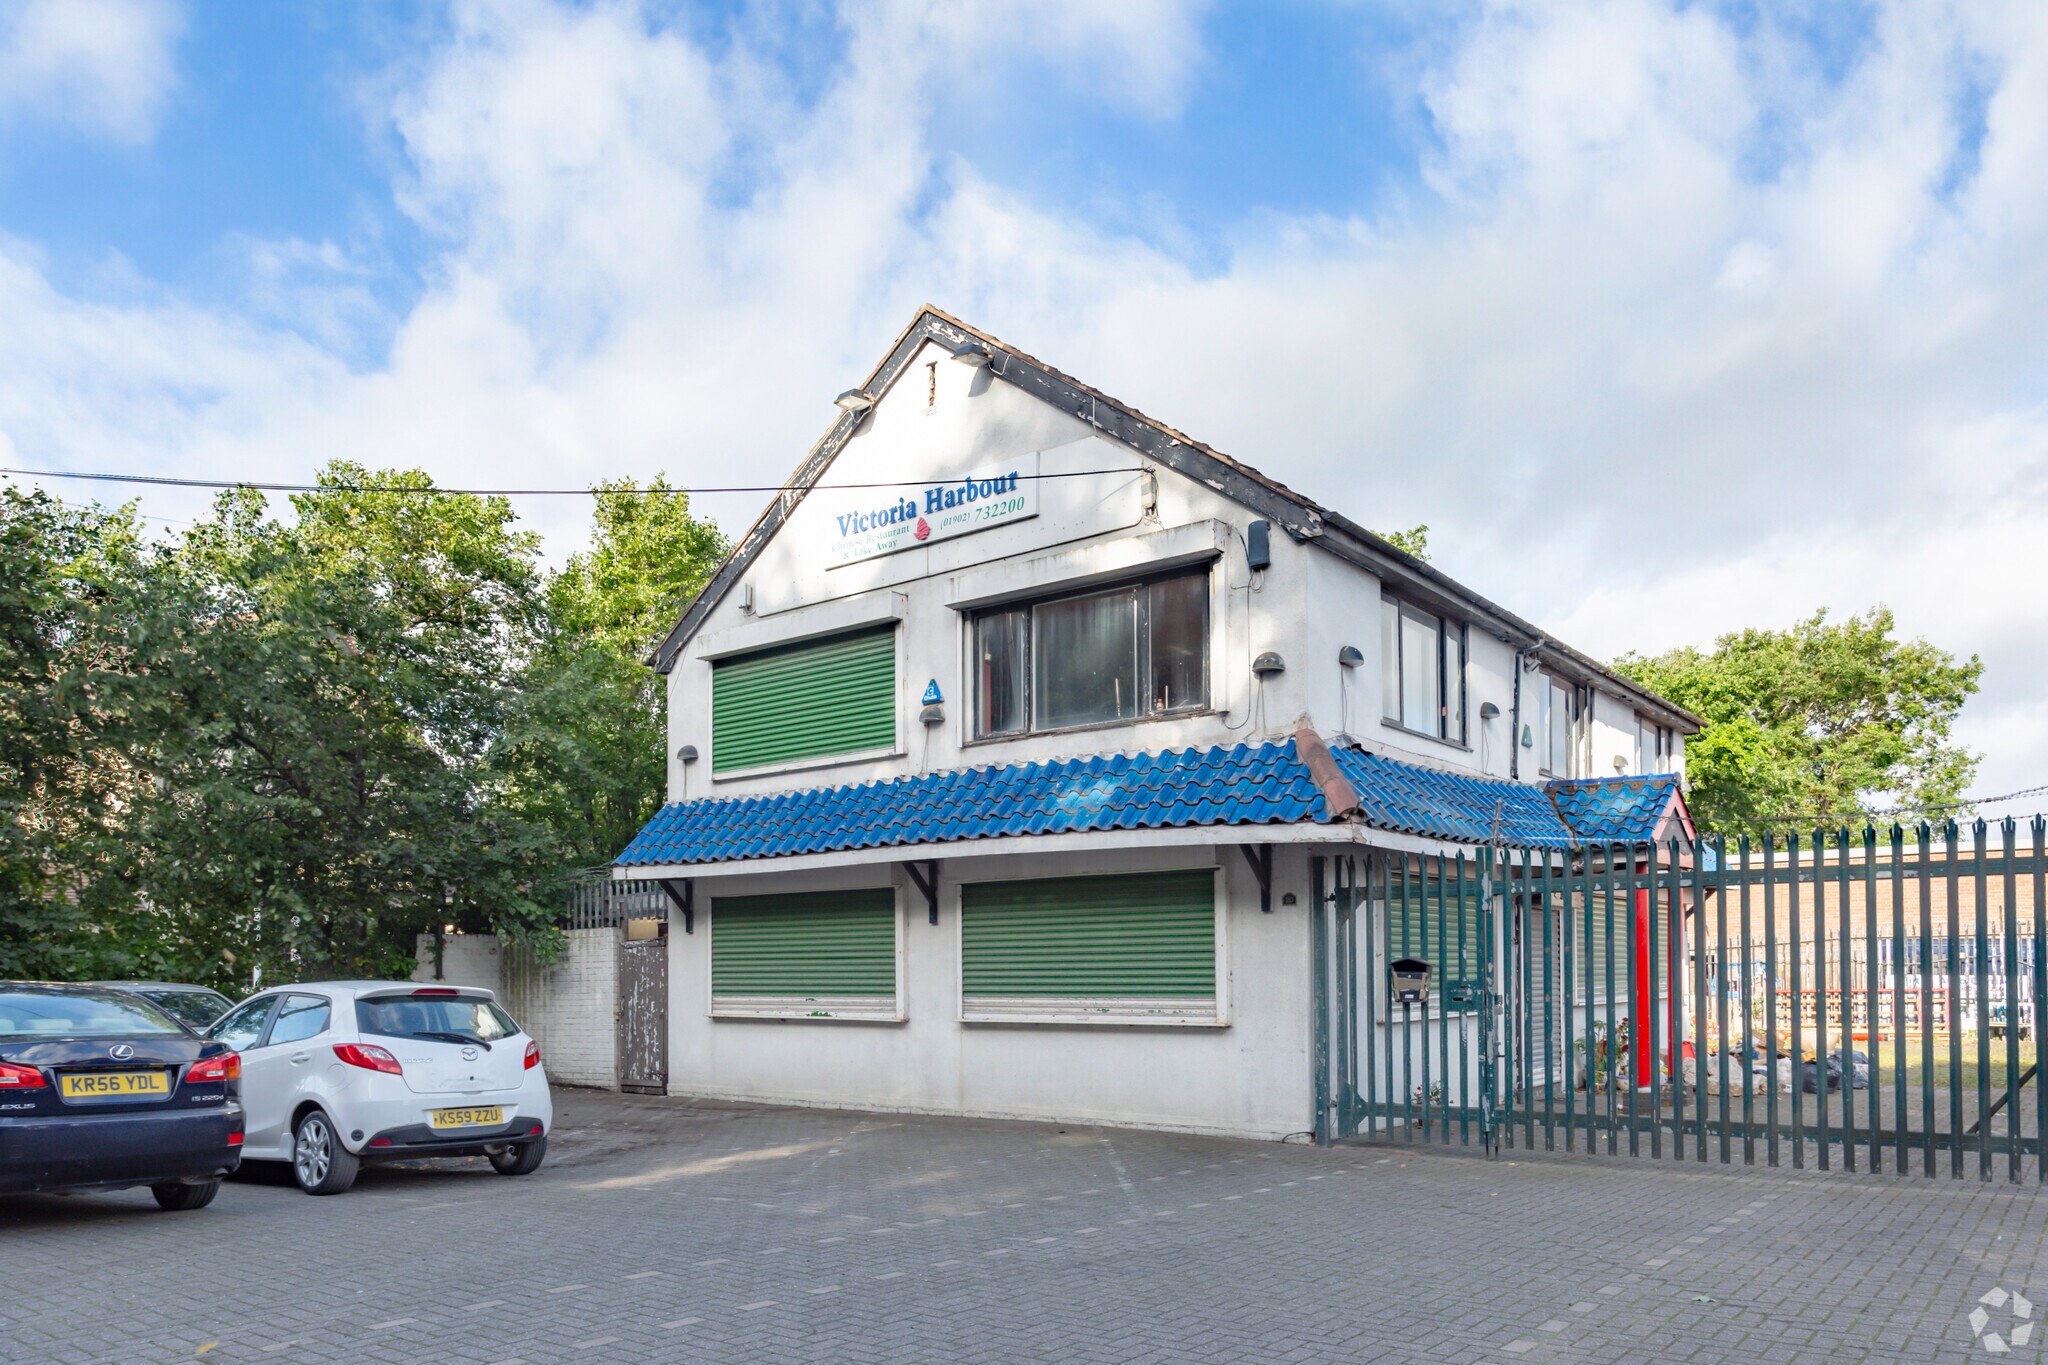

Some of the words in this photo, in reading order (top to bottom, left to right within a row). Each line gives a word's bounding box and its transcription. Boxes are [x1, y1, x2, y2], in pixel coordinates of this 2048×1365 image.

[836, 497, 917, 537] Victoria
[924, 470, 1019, 514] Harbour
[940, 512, 970, 530] (01902)
[975, 496, 1025, 521] 732200
[866, 525, 911, 544] Restaurant
[876, 539, 898, 552] Away
[71, 1076, 121, 1092] KR56
[125, 1075, 160, 1090] YDL
[439, 1110, 472, 1125] KS59
[475, 1109, 498, 1122] ZZU
